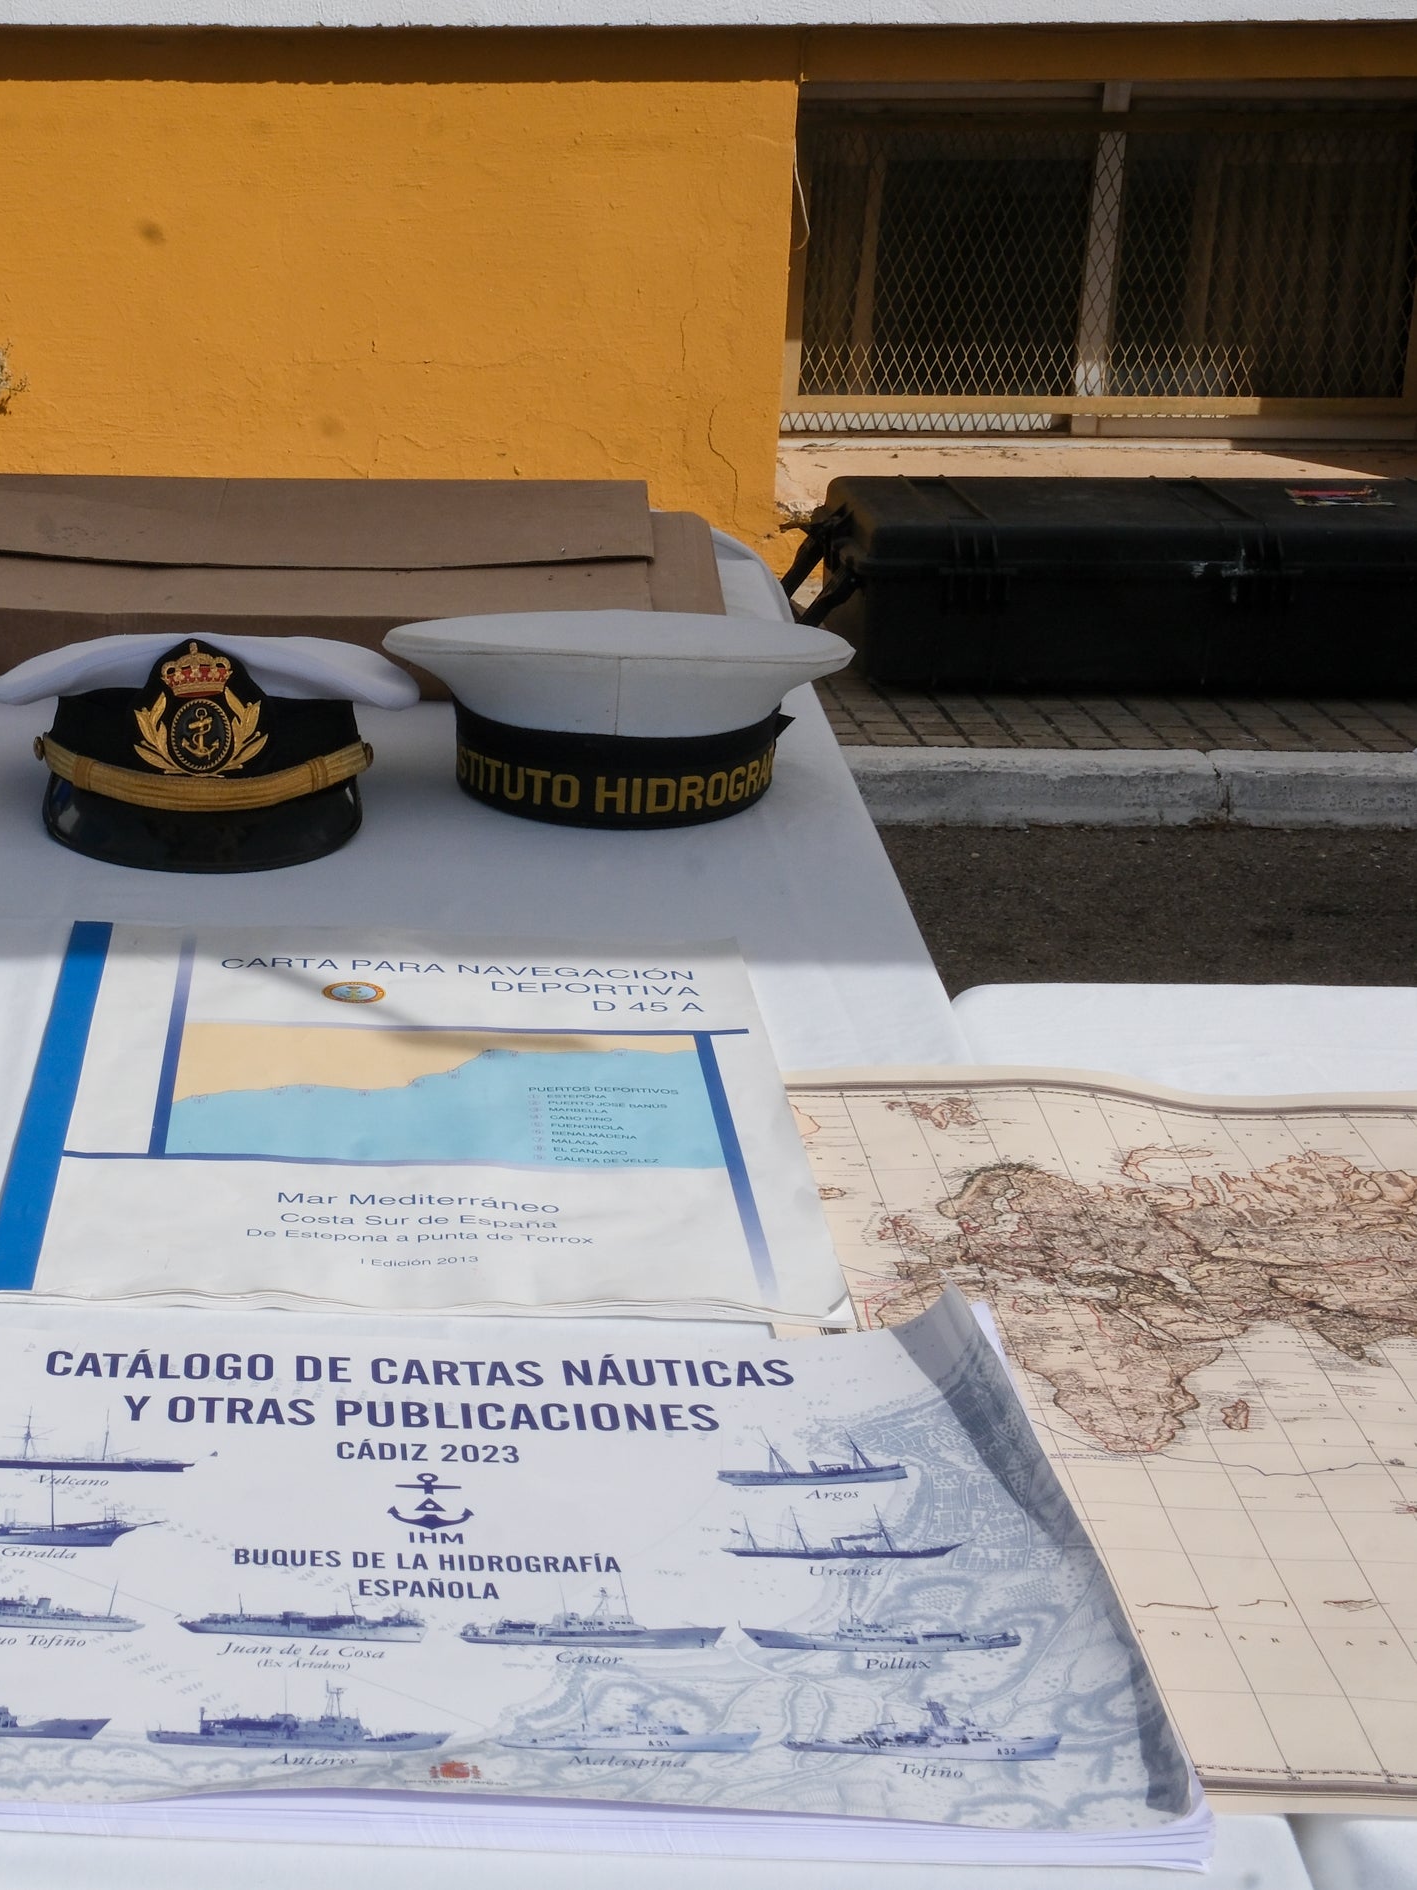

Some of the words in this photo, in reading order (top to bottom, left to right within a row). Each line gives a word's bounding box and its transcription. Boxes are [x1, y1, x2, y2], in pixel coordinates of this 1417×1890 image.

[221, 957, 339, 970] CARTA
[351, 959, 445, 973] PARA
[458, 964, 694, 981] NAVEGACIÓN
[491, 980, 700, 997] DEPORTIVA
[593, 1000, 616, 1012] D
[628, 1001, 668, 1013] 45
[681, 1002, 705, 1013] A
[594, 1086, 679, 1095] DEPORTIVOS
[277, 1192, 338, 1205] Mar
[349, 1193, 560, 1214] Mediterráneo
[280, 1212, 354, 1226] Costa
[365, 1214, 409, 1226] Sur
[418, 1214, 449, 1226] de
[459, 1214, 558, 1230] España
[246, 1228, 277, 1239] De
[285, 1229, 388, 1243] Estepona
[396, 1234, 409, 1243] a
[417, 1231, 479, 1244] punta
[486, 1231, 513, 1242] de
[520, 1233, 594, 1245] Torrox
[371, 1257, 432, 1268] Edición
[437, 1255, 479, 1266] 2013
[45, 1348, 275, 1382] CATÁLOGO
[295, 1355, 352, 1383] DE
[370, 1357, 544, 1387] CARTAS
[561, 1353, 795, 1388] NÁUTICAS
[123, 1395, 152, 1422] Y
[167, 1396, 316, 1427] OTRAS
[336, 1399, 720, 1432] PUBLICACIONES
[336, 1438, 428, 1462] CÁDIZ
[440, 1443, 520, 1464] 2023
[38, 1474, 110, 1487] Vulcano
[805, 1488, 860, 1502] Argos
[408, 1532, 464, 1545] IHM
[2, 1546, 78, 1559] Giralda
[233, 1548, 342, 1568] BUQUES
[352, 1551, 385, 1570] DE
[397, 1552, 428, 1571] LA
[439, 1552, 622, 1573] HIDROGRAFÍA
[809, 1565, 883, 1576] Urania
[358, 1577, 500, 1600] ESPAÑOLA
[26, 1633, 87, 1649] Tofiño
[217, 1641, 272, 1656] Juan
[279, 1643, 302, 1656] de
[309, 1644, 329, 1657] la
[338, 1645, 386, 1659] Cosa
[556, 1651, 624, 1665] Castor
[865, 1657, 932, 1670] Pollux
[648, 1739, 670, 1748] A31
[272, 1752, 358, 1766] Antares
[568, 1754, 687, 1769] Malaspina
[896, 1762, 964, 1780] Tofiño
